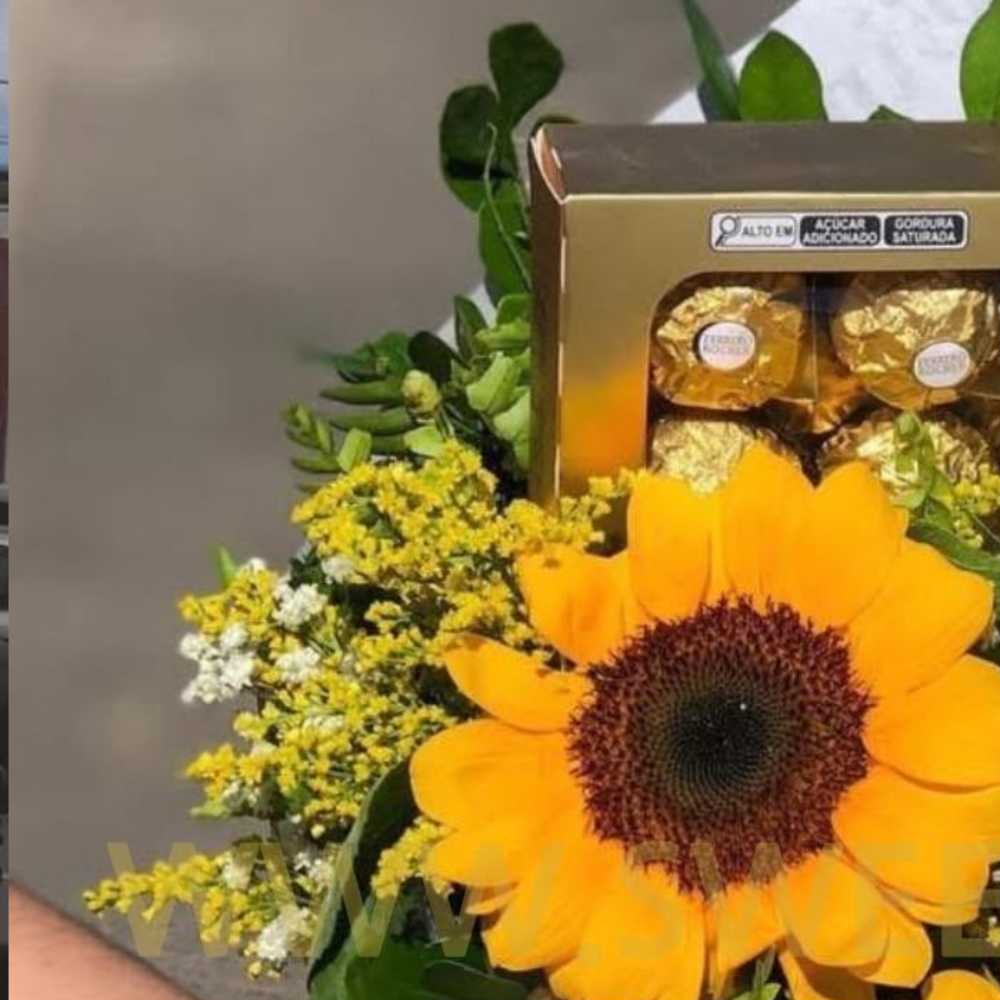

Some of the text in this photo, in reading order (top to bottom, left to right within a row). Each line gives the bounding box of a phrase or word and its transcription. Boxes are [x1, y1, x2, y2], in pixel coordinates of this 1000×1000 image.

[894, 217, 955, 230] GORDURA
[741, 226, 795, 237] ALTO EM
[802, 231, 879, 244] ADICIONADO
[893, 231, 957, 244] SATURADA
